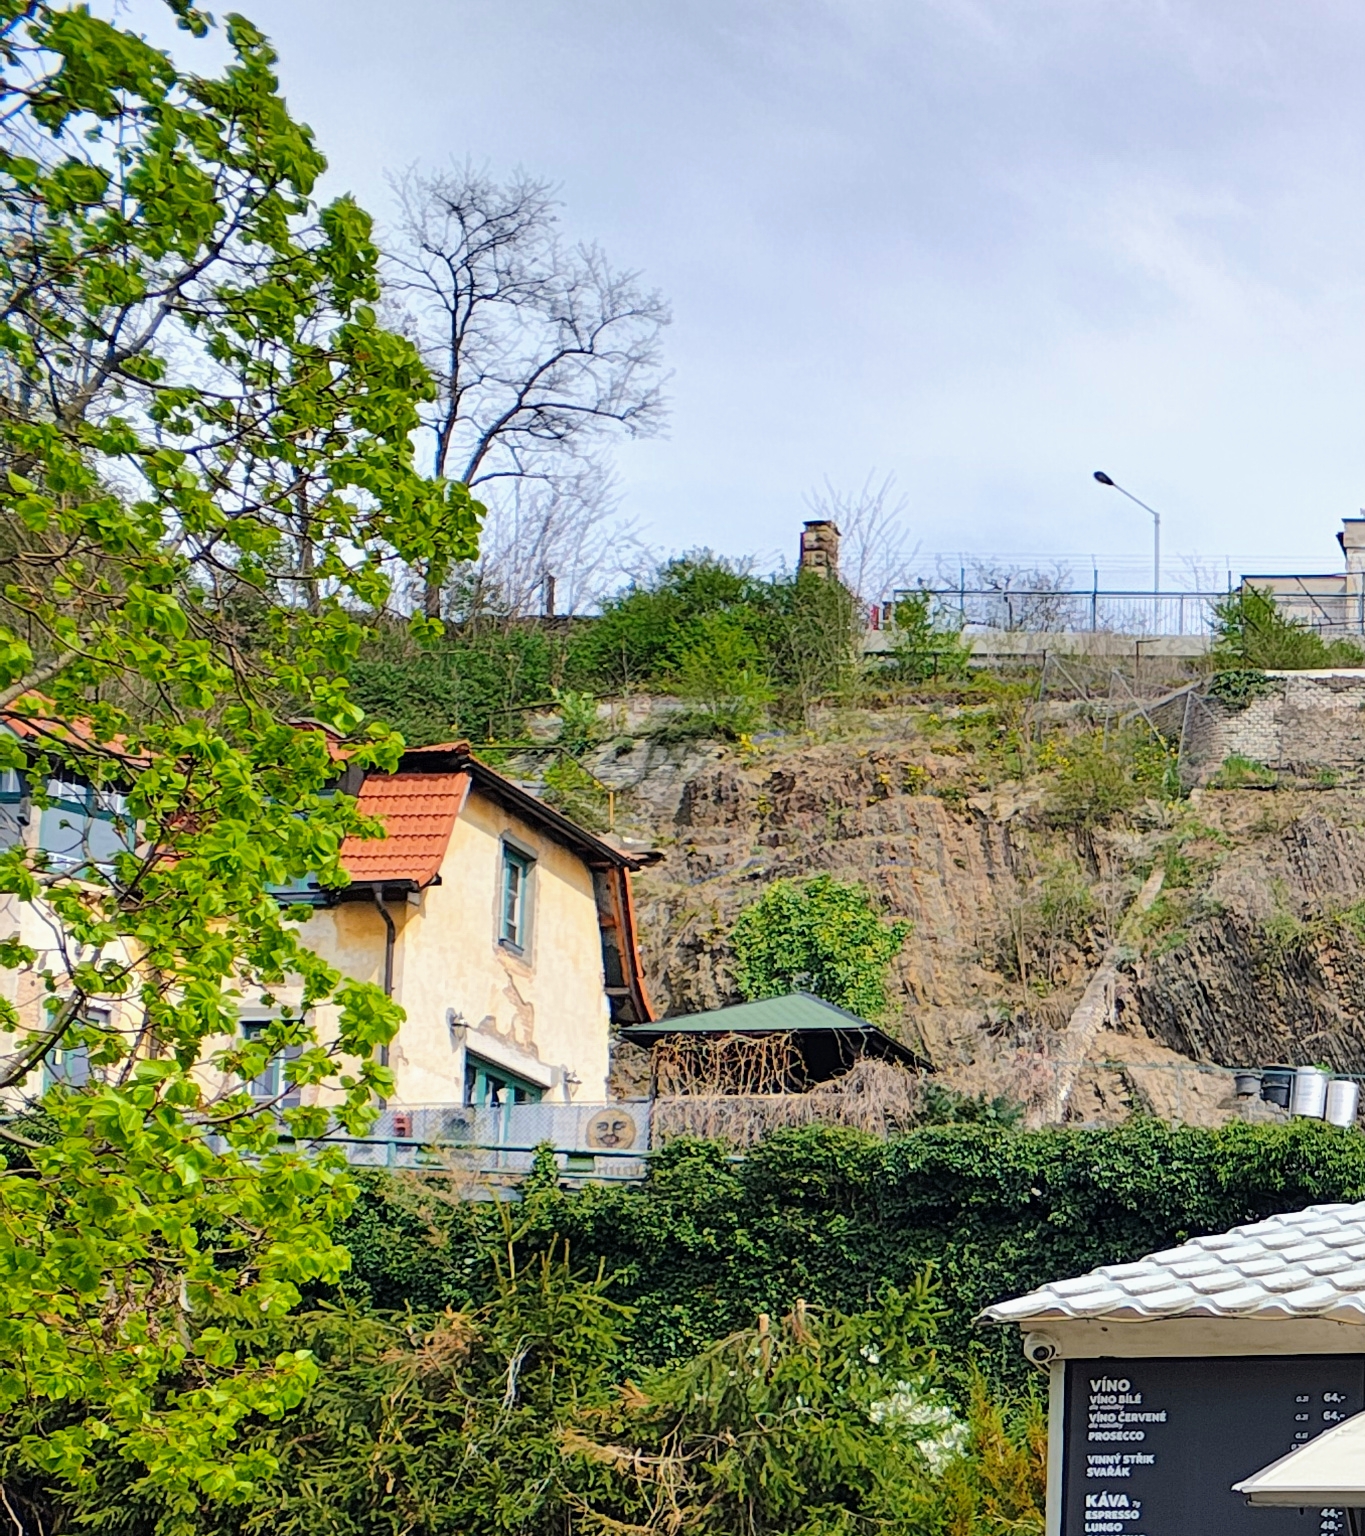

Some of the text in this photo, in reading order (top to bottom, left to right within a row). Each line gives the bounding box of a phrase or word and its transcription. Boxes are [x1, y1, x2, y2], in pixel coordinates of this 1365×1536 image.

[1090, 1376, 1130, 1392] VÍNO
[1089, 1393, 1141, 1404] VÍNO BÍLÉ
[1089, 1410, 1166, 1422] VÍNO ČERVENÉ
[1088, 1431, 1144, 1440] PROSECCO
[1087, 1452, 1154, 1464] VINNÝ STŘIK
[1087, 1465, 1130, 1477] SVAŘÁK
[1086, 1491, 1129, 1507] KÁVA
[1085, 1510, 1139, 1519] ESPRESSO
[1085, 1523, 1122, 1532] LUNGO
